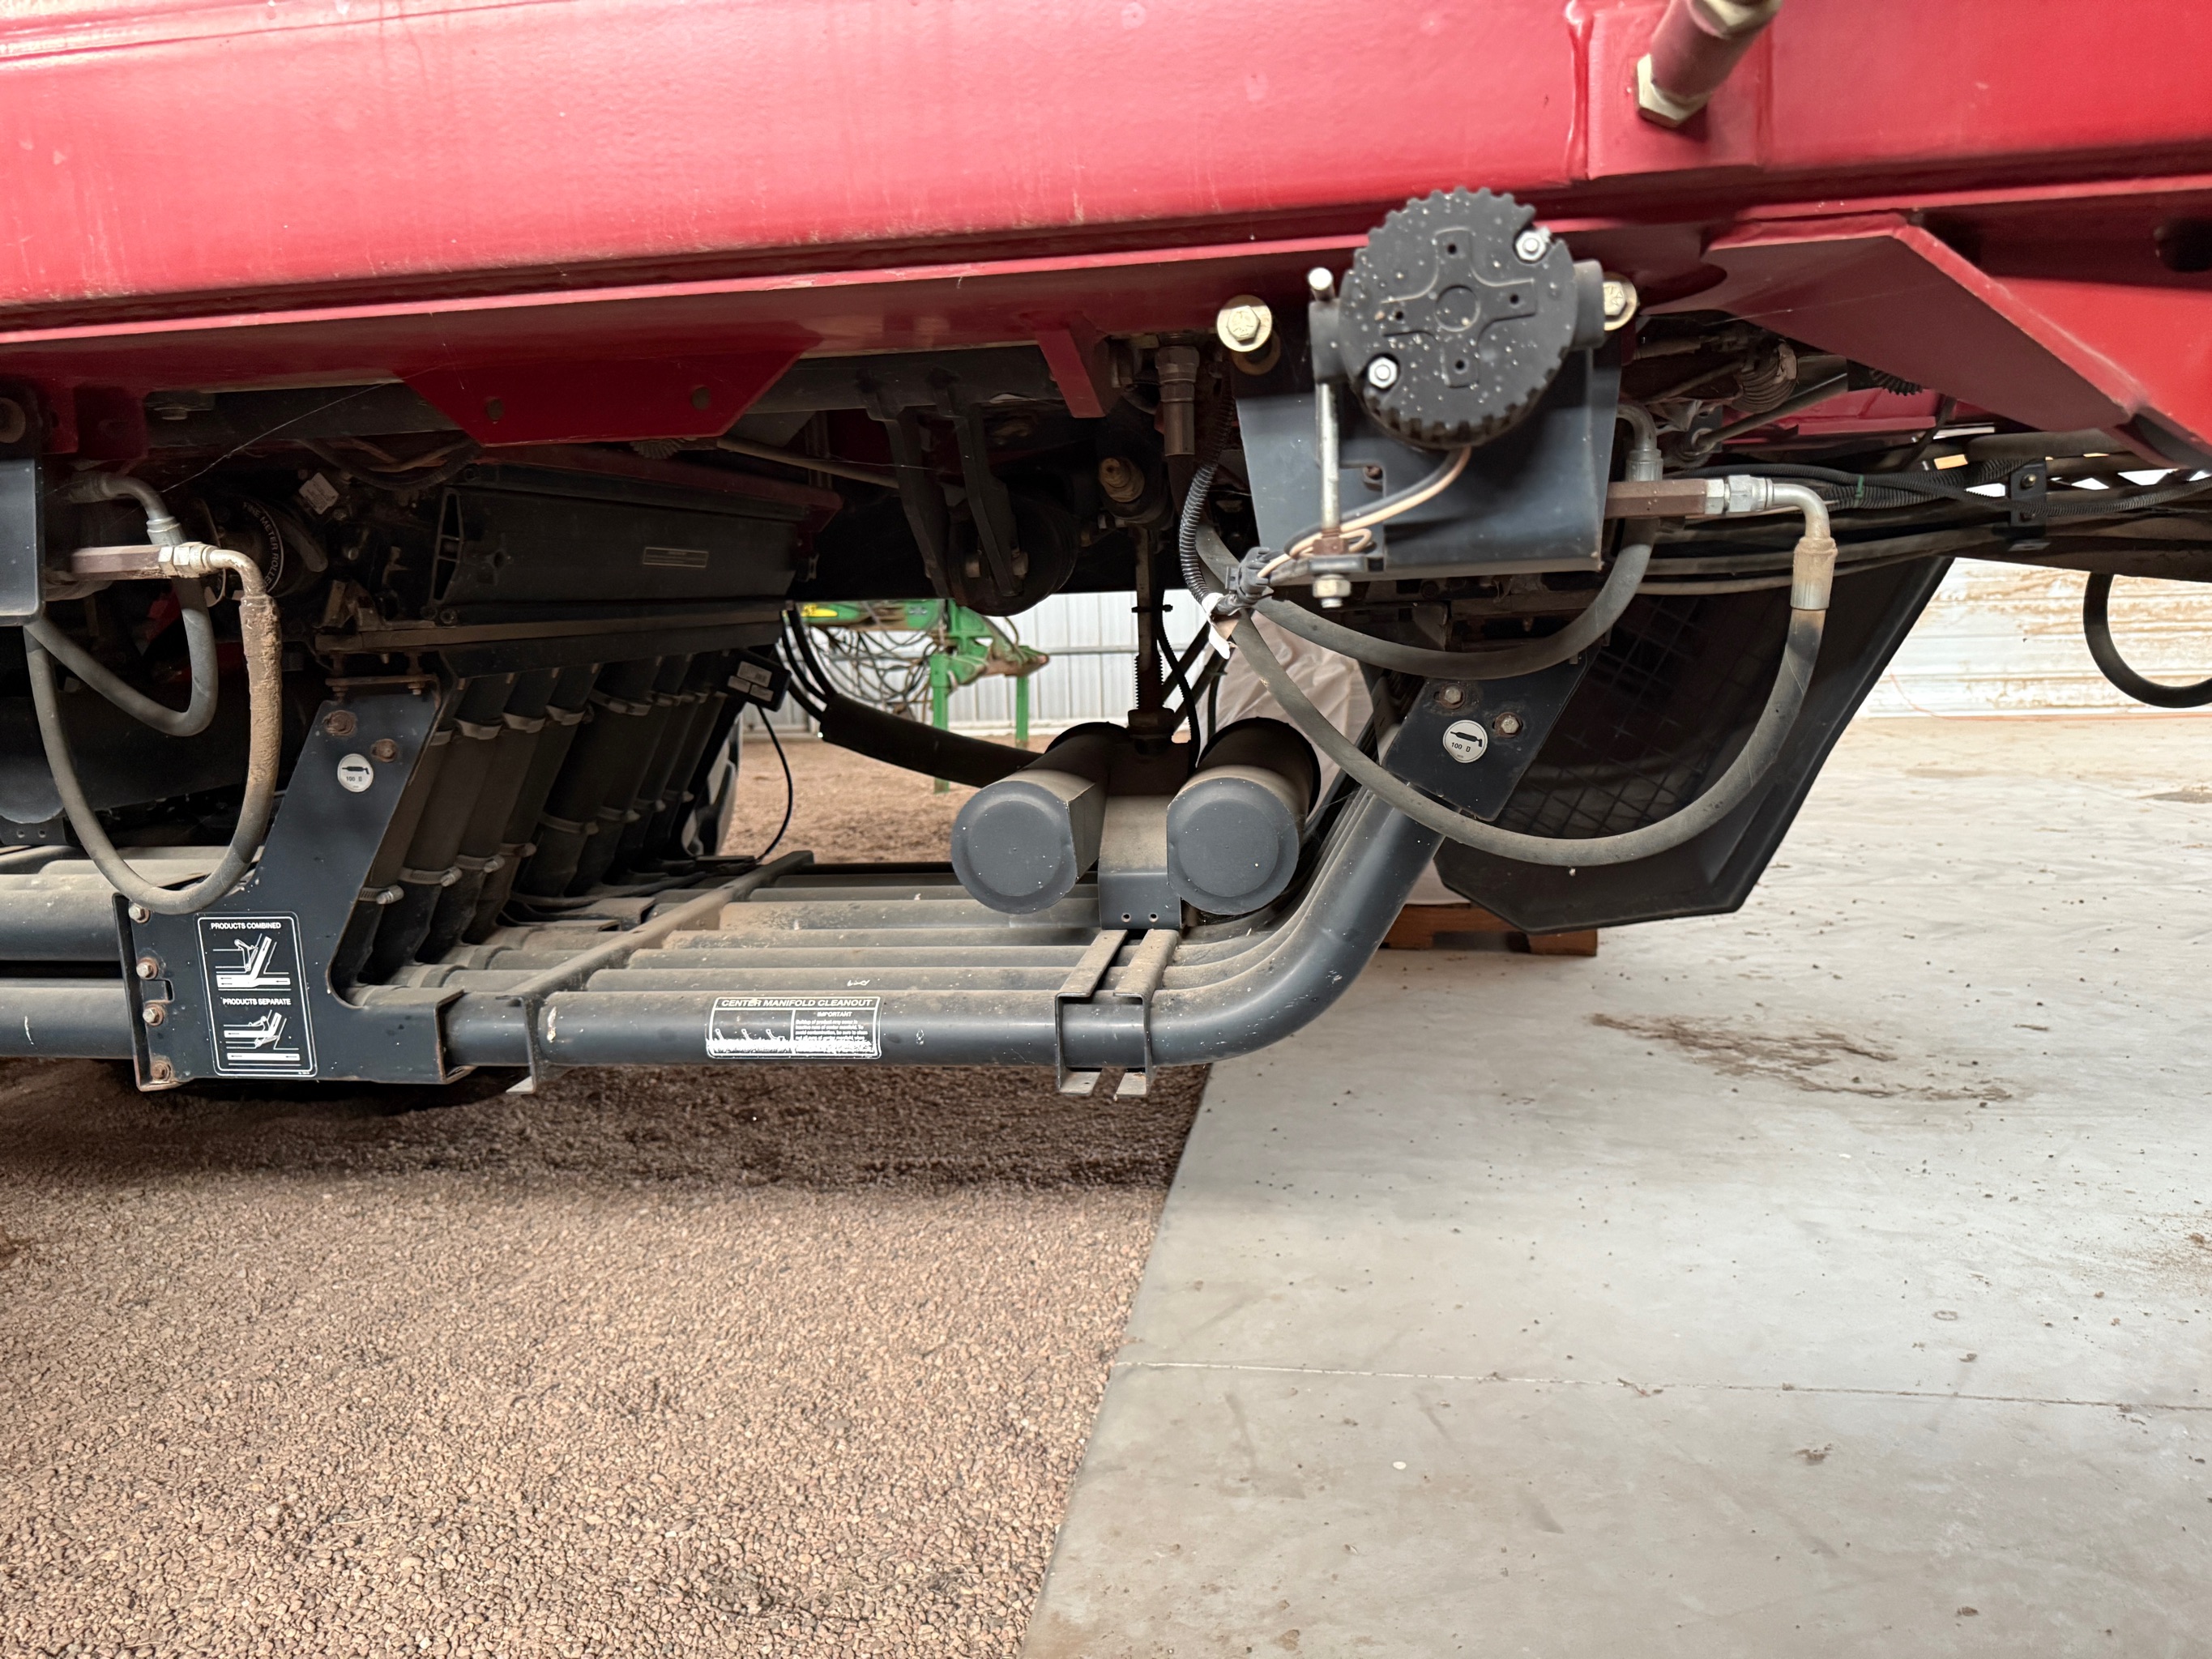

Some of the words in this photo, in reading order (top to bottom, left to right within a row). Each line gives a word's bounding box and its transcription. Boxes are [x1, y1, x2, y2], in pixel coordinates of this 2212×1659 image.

[259, 516, 279, 552] METER
[264, 553, 279, 586] ROLLE
[1451, 742, 1463, 750] 100
[211, 922, 246, 930] PRODUCTS
[223, 998, 258, 1006] PRODUCTS
[258, 998, 292, 1006] SEPARATE
[721, 999, 762, 1007] CENTER
[763, 999, 816, 1007] MANIFOLD
[817, 999, 873, 1007] CLEANOUT
